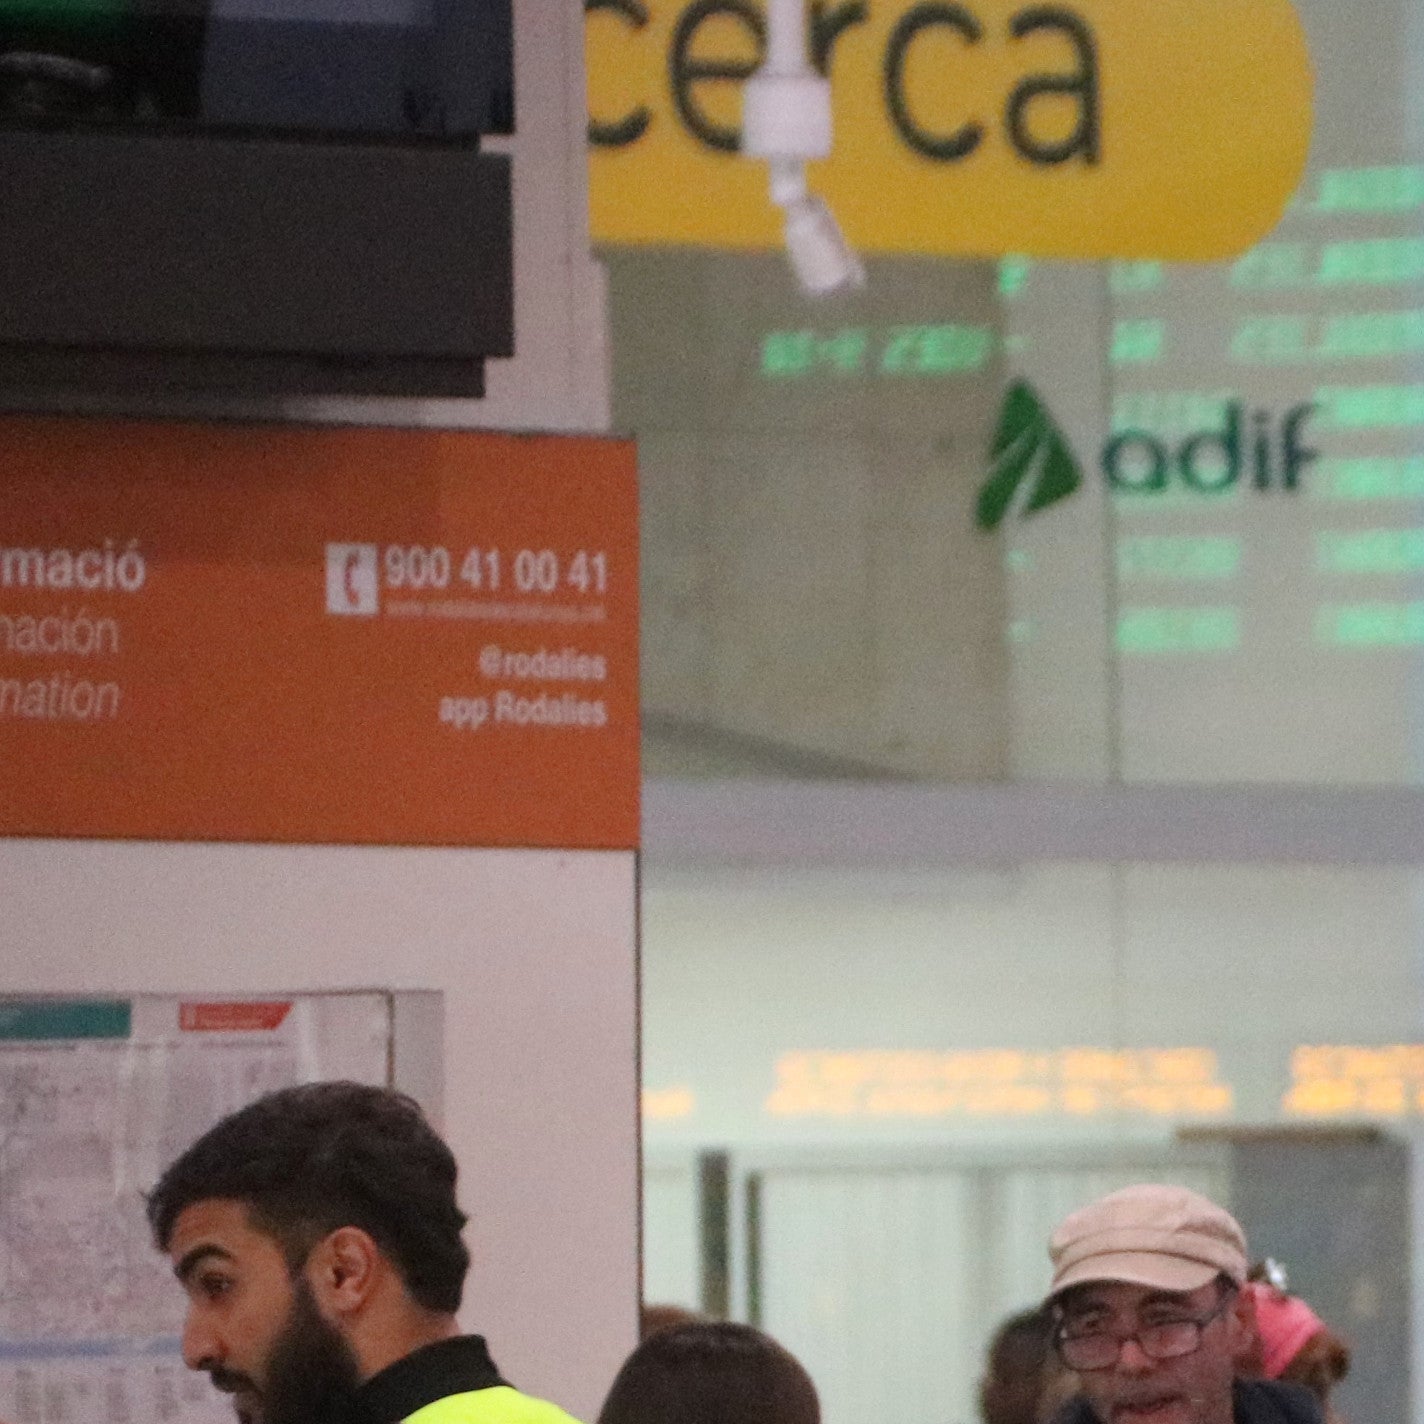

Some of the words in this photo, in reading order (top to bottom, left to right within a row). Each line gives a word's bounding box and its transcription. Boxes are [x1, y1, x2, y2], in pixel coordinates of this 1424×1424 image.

[1104, 399, 1319, 496] adif
[385, 546, 450, 589] 900
[460, 547, 499, 590] 41
[513, 549, 559, 593] 00
[567, 551, 606, 594] 41
[438, 697, 489, 730] app
[496, 691, 608, 727] Rodalies
